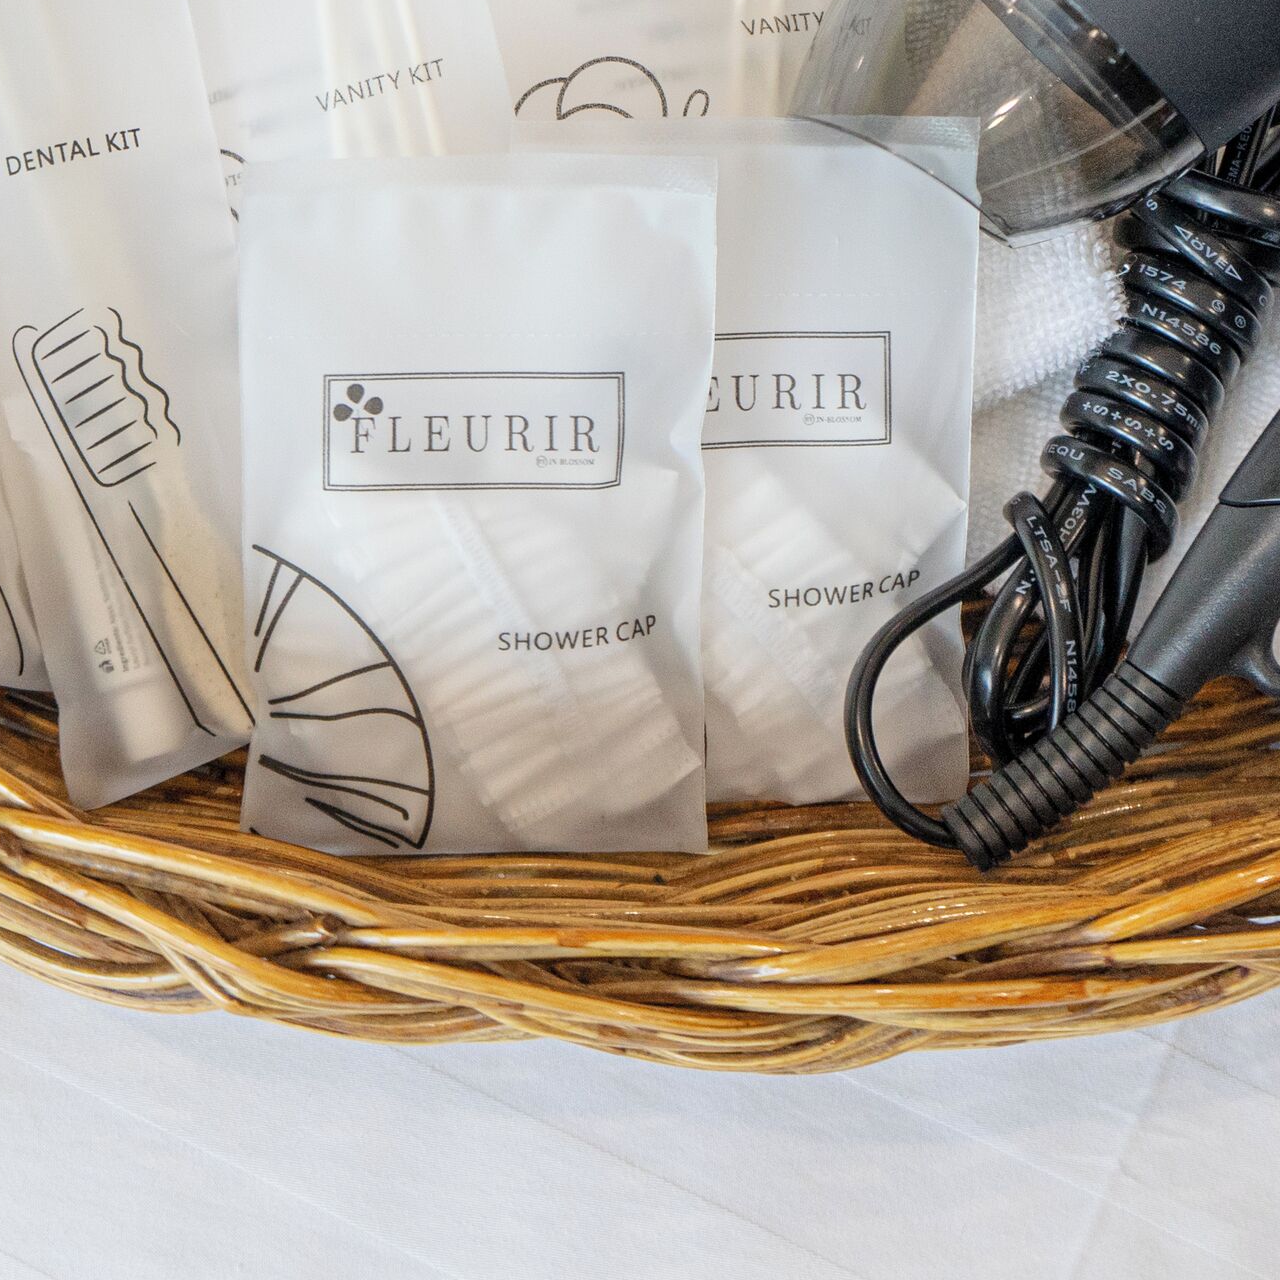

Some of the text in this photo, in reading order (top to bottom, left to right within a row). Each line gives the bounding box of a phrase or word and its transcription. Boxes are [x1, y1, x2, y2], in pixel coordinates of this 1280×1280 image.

[741, 11, 825, 36] VANITY
[315, 58, 444, 112] VANITY KIT
[5, 128, 141, 176] DENTAL KIT
[1139, 264, 1187, 290] 1574
[1140, 303, 1222, 355] N14586
[350, 415, 600, 454] FLEURIR
[1107, 467, 1167, 514] SABS
[768, 570, 920, 608] SHOWER CAP
[498, 614, 657, 651] SHOWER CAP
